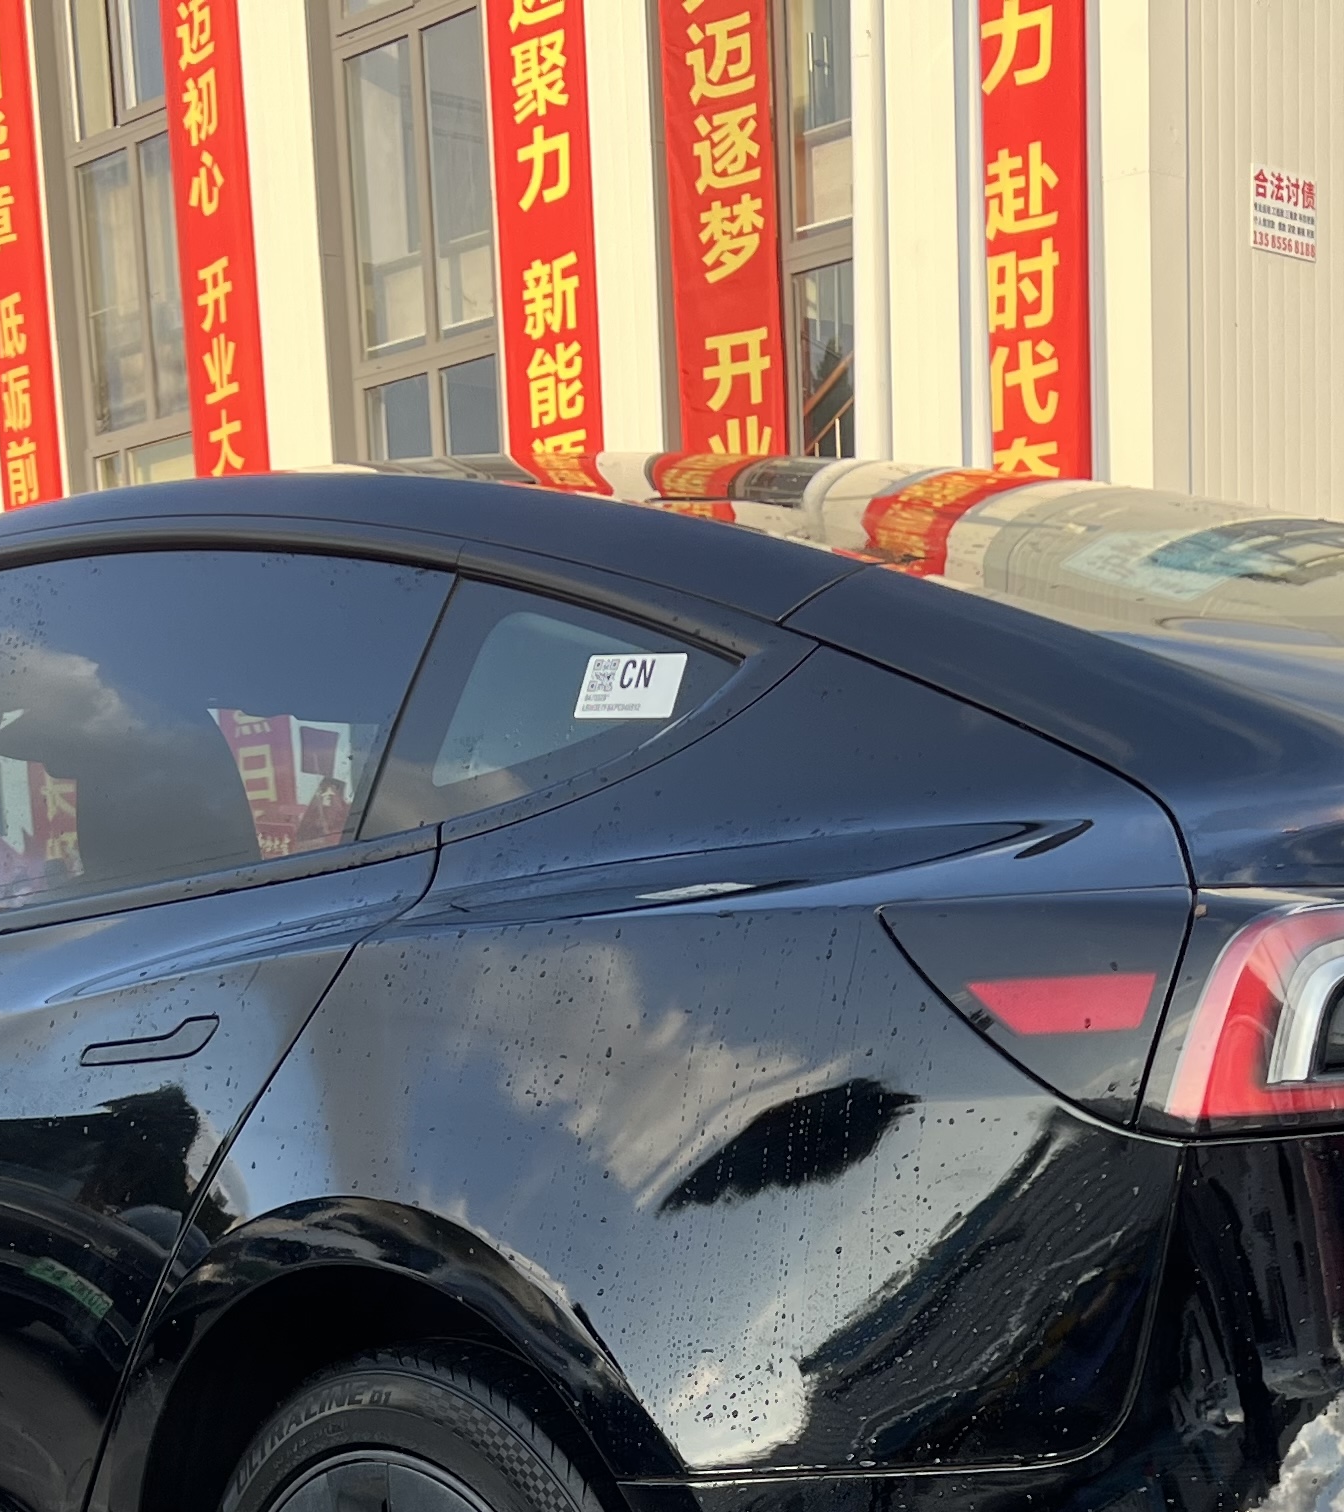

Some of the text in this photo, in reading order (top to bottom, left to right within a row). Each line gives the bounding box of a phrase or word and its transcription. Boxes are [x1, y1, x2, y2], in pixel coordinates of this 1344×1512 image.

[176, 0, 225, 217] 迈初心
[682, 0, 764, 284] 迈逐梦
[1254, 169, 1316, 210] 合法讨债
[197, 256, 245, 477] 开业大
[619, 659, 656, 689] CN
